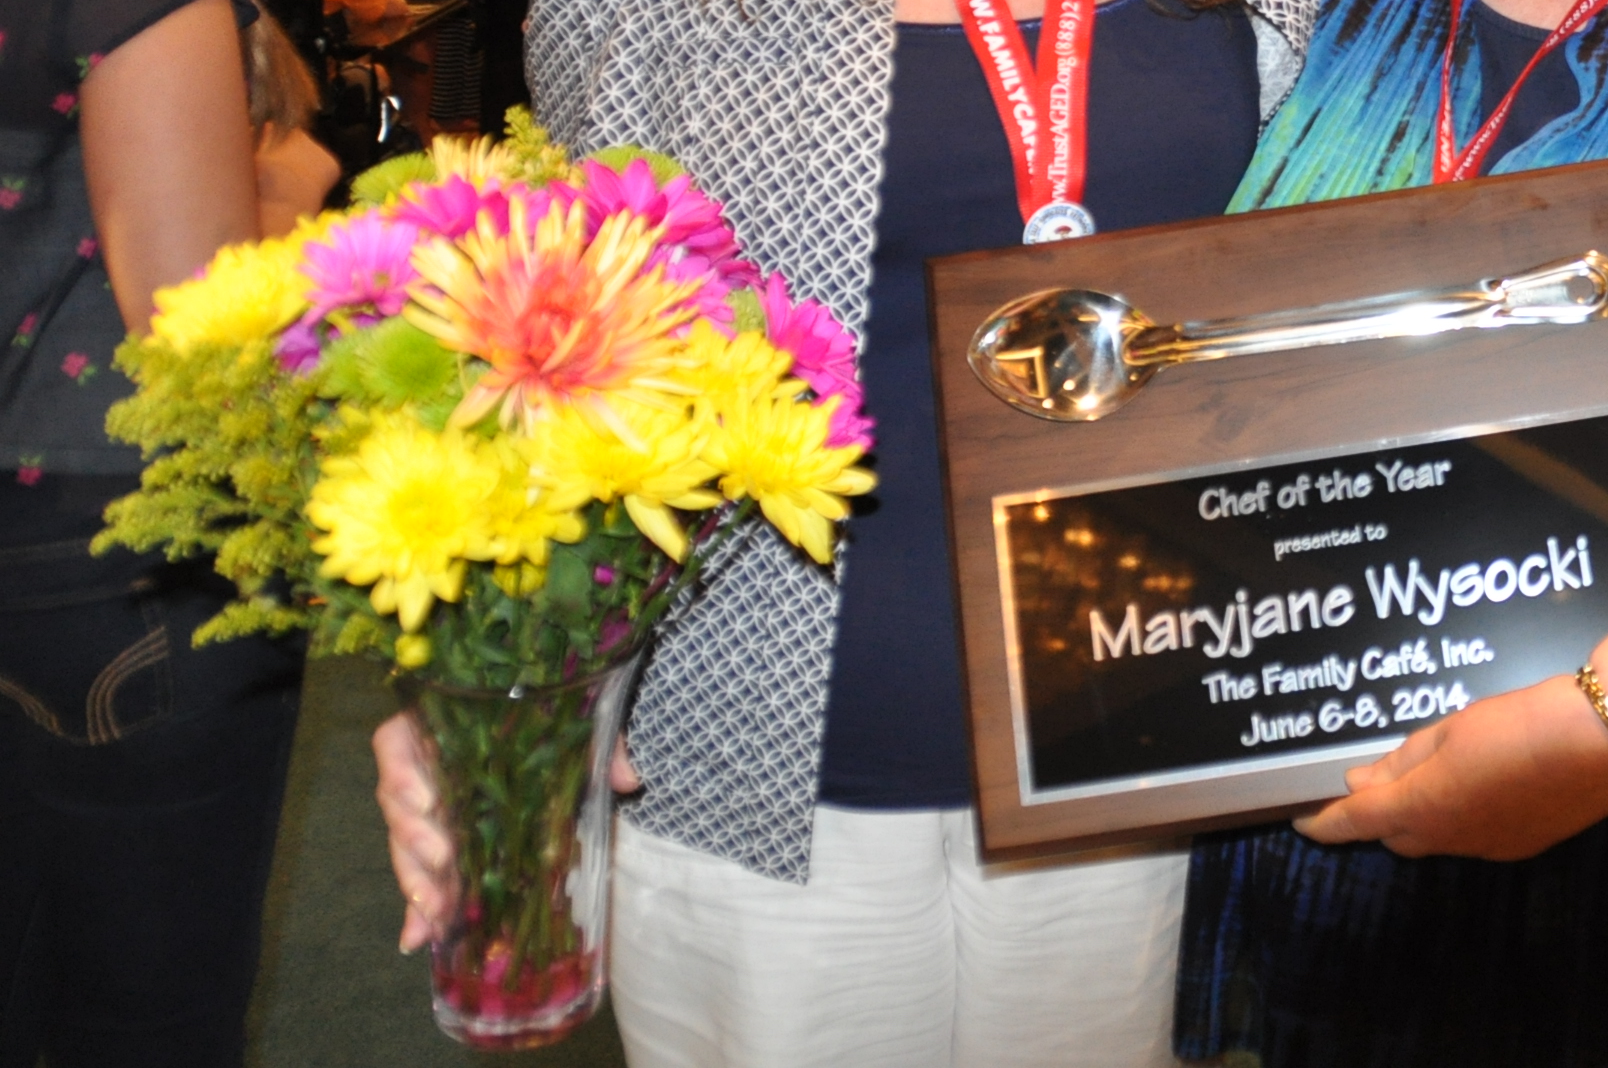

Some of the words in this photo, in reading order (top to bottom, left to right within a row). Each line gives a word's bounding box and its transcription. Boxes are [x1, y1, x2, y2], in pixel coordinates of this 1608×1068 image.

[1199, 479, 1272, 520] Chef
[1276, 473, 1312, 509] of
[1315, 469, 1373, 503] the
[1375, 459, 1452, 492] Year
[1273, 523, 1362, 561] presented
[1364, 523, 1388, 541] to
[1088, 585, 1355, 662] Maryjane
[1365, 534, 1594, 626] Wysocki
[1202, 671, 1258, 703] The
[1261, 656, 1357, 692] Family
[1361, 636, 1438, 681] Café,
[1441, 636, 1495, 668] Inc.
[1240, 713, 1315, 747] June
[1318, 693, 1390, 732] 6-8,
[1391, 682, 1470, 722] 2014
